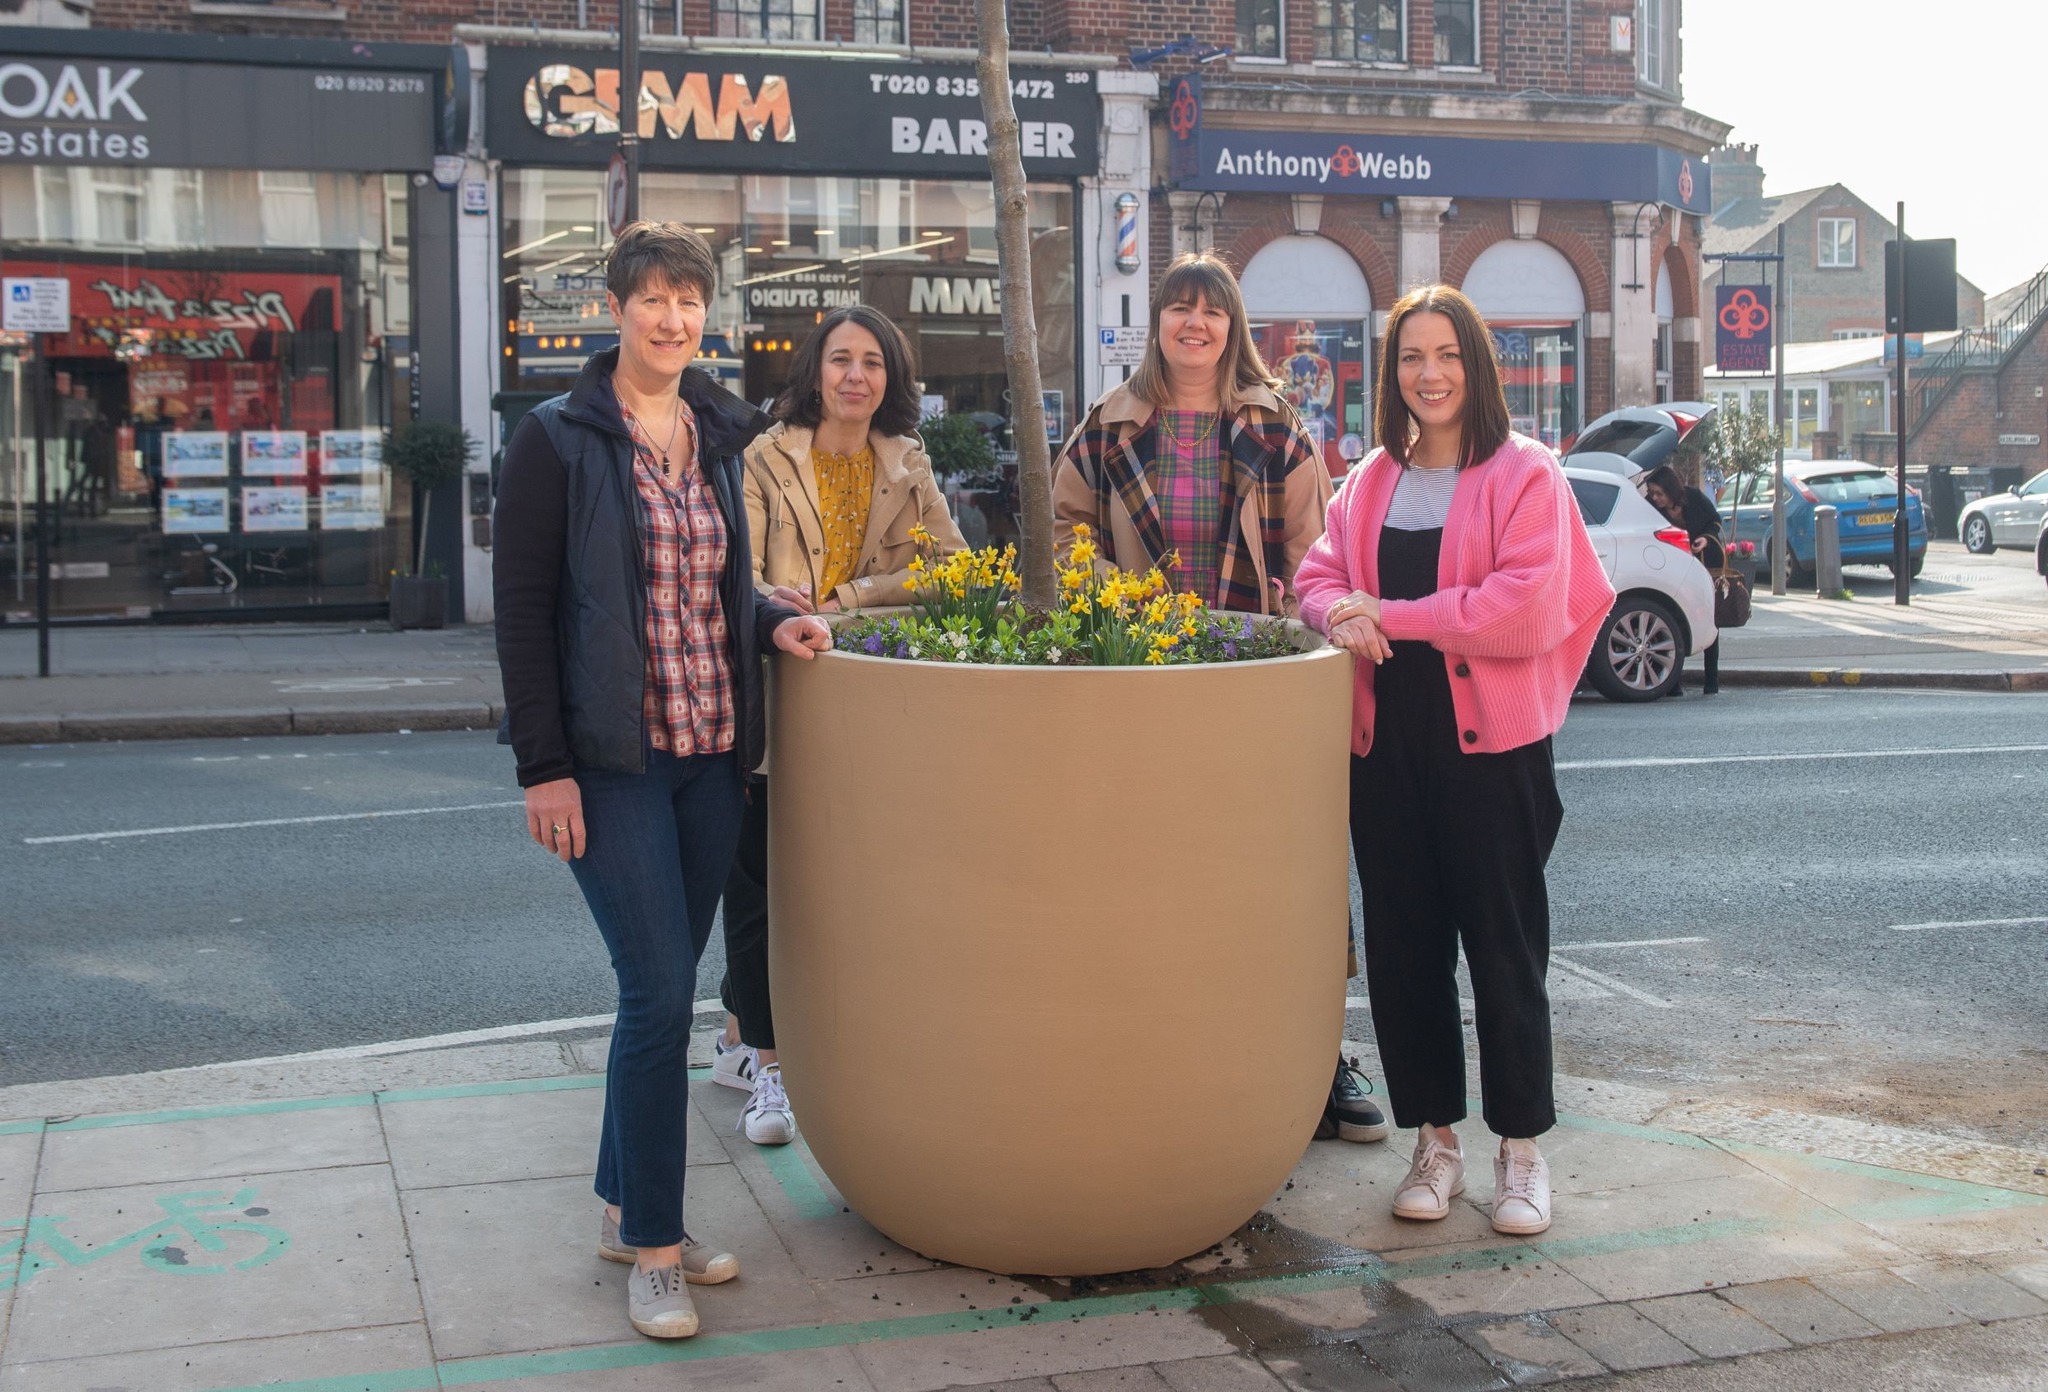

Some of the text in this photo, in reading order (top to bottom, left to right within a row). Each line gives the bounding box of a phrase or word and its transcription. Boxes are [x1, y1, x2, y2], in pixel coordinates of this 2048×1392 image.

[314, 75, 425, 93] 020 8920 2678
[935, 76, 981, 97] 835
[1065, 72, 1089, 84] 350
[0, 62, 148, 121] OAK
[0, 126, 150, 159] estates
[891, 116, 1076, 158] BARER
[1215, 147, 1331, 183] Anthony
[1356, 151, 1432, 180] Webb
[1722, 344, 1766, 357] ESTATE
[1721, 357, 1768, 369] AGENTS
